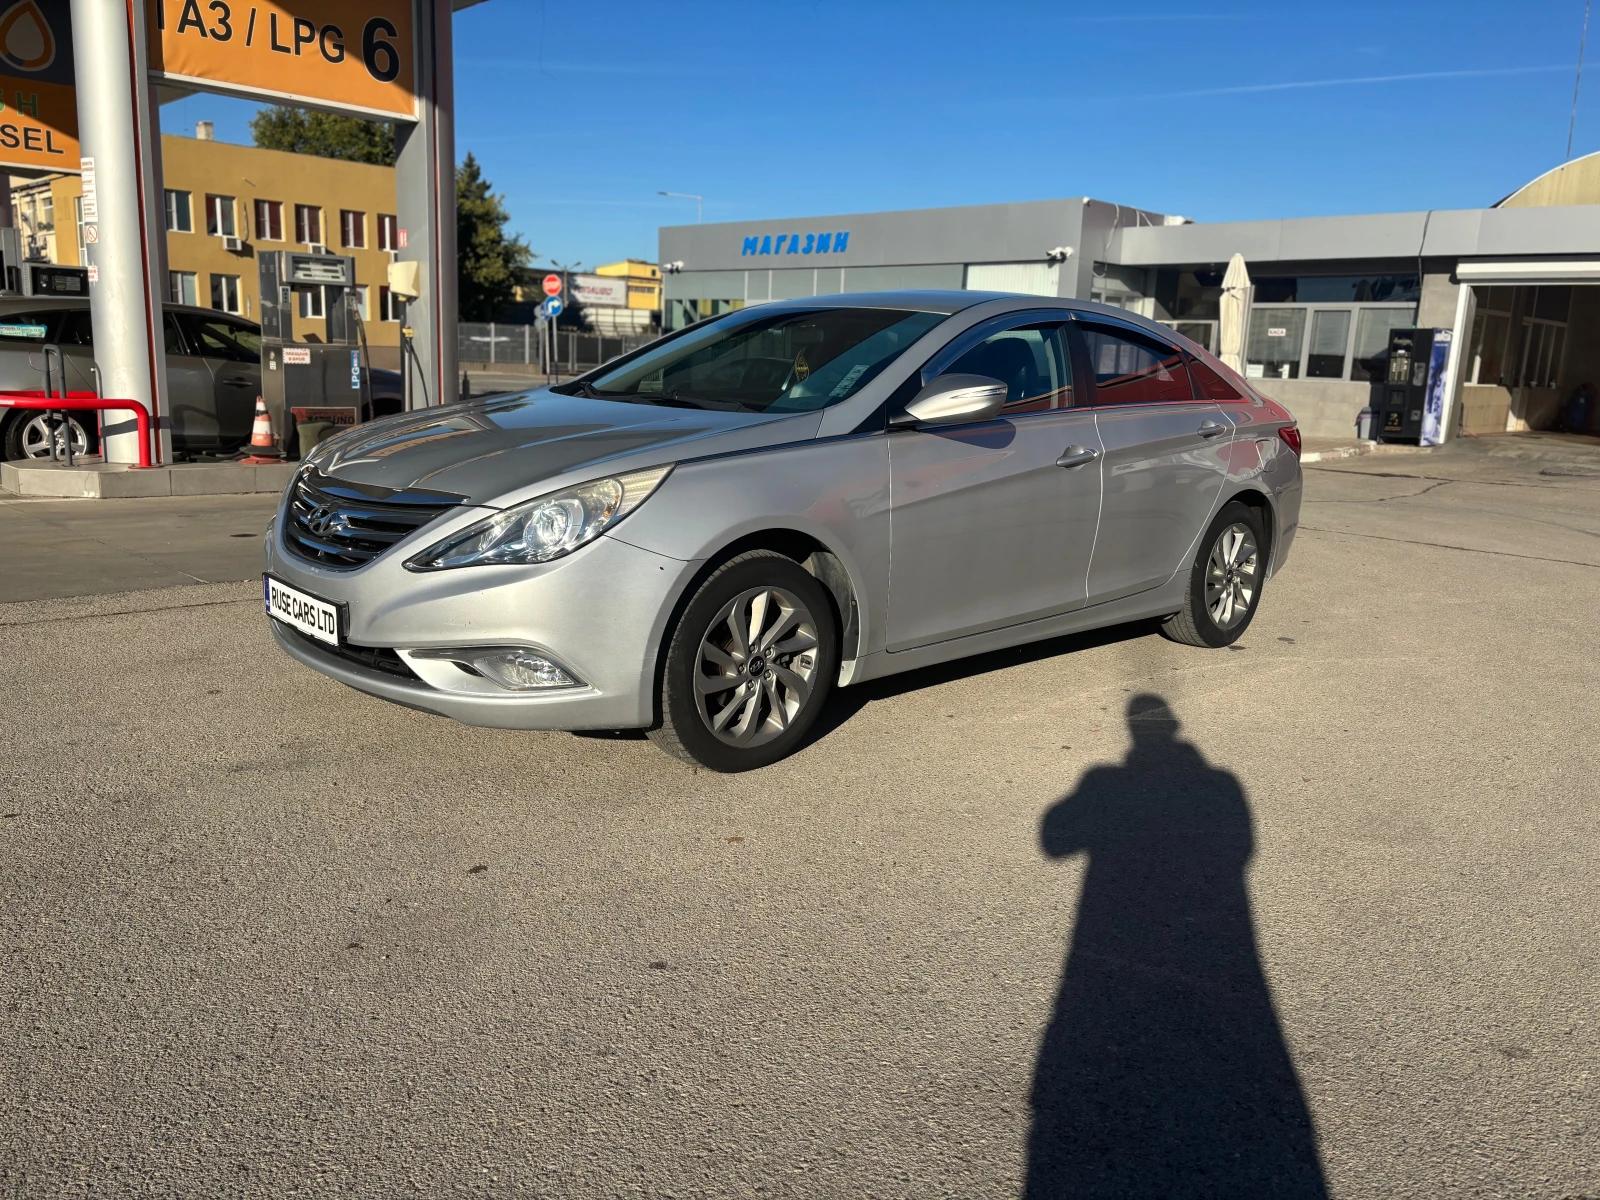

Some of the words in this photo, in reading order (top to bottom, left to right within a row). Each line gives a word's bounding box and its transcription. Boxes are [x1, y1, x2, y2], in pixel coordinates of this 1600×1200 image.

[245, 7, 257, 47] /
[270, 12, 346, 64] LPG
[361, 16, 400, 83] 6
[741, 231, 850, 256] МАГАЗИН
[351, 366, 360, 389] LPG
[271, 586, 292, 616] RUSE
[292, 597, 316, 627] CARS
[317, 607, 335, 635] LTD
